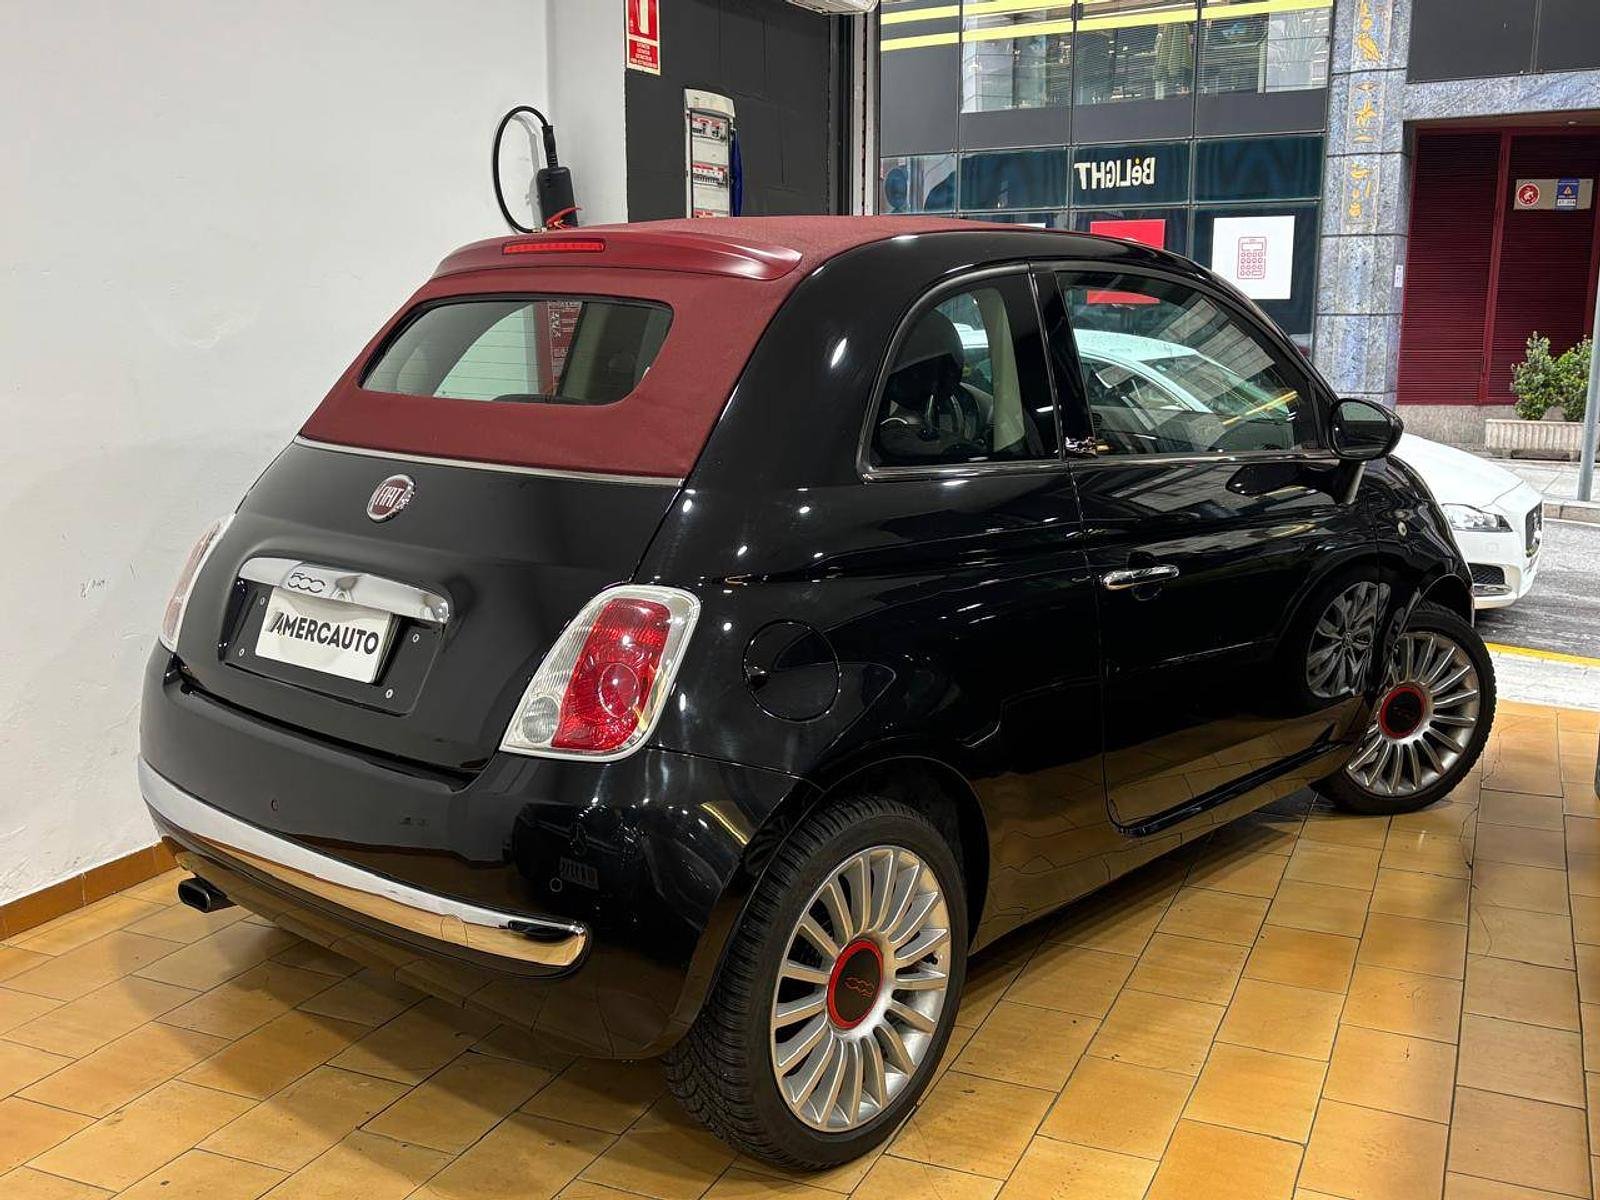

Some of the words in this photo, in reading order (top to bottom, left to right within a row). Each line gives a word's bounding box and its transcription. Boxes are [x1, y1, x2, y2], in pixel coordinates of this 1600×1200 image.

[374, 486, 405, 508] FIAT
[288, 572, 326, 594] 500
[267, 610, 379, 655] AMERCAUTO
